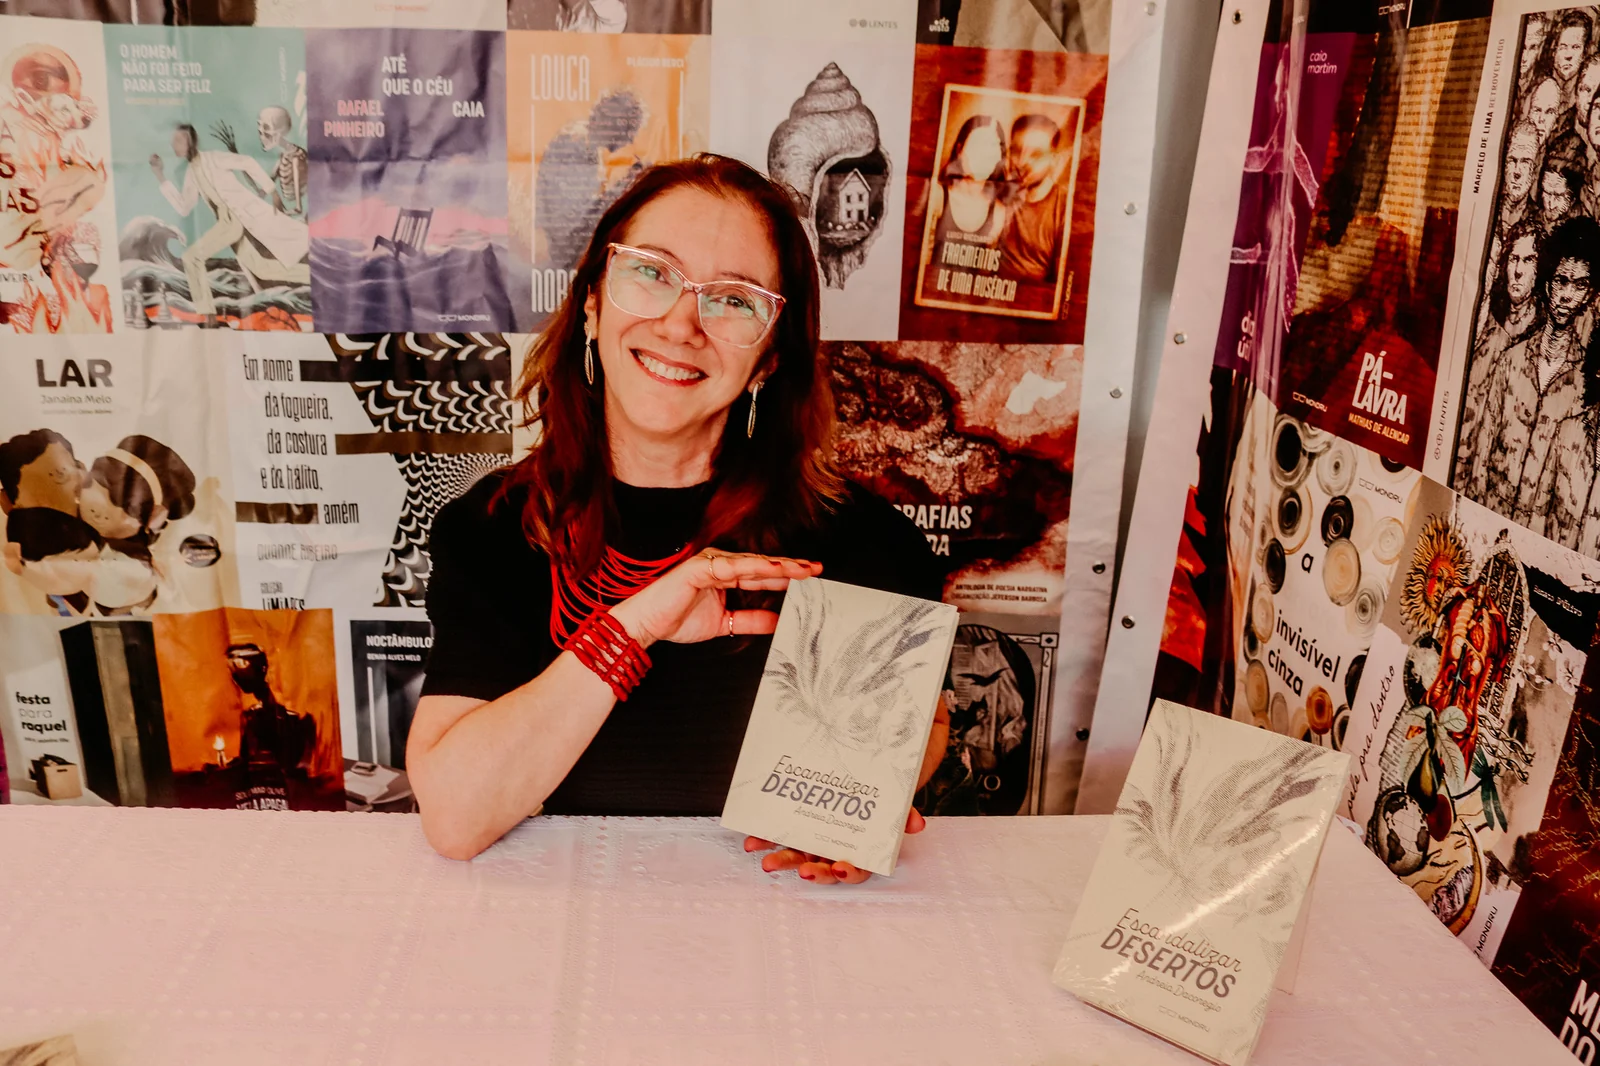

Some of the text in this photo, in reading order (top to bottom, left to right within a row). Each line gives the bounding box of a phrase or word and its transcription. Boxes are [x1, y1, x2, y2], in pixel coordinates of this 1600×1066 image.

[869, 20, 898, 29] LENTES
[120, 44, 178, 59] O HOMEM
[1310, 50, 1328, 62] caio
[121, 59, 202, 76] NÃO FOI FEITO
[381, 53, 407, 74] ATÉ
[1307, 62, 1337, 74] martim
[123, 78, 211, 94] PARA SER FELIZ
[382, 75, 453, 97] QUE O CÉU
[337, 100, 384, 116] RAFAEL
[452, 101, 484, 118] CAIA
[1473, 38, 1505, 194] MARCELO DE LIMA RETROVERTIGO
[324, 121, 385, 138] PINHEIRO
[942, 242, 1001, 271] FRAGMENTOS
[937, 269, 1017, 302] DE UMA AUSÊNCIA
[36, 358, 113, 388] LAR
[243, 354, 294, 382] Em nome
[264, 391, 333, 422] da fogueira,
[1352, 379, 1408, 426] LAVRA
[1439, 389, 1449, 432] LENTES
[1348, 412, 1410, 446] MATHIAS DE ALENCAR
[267, 428, 328, 456] da costura
[260, 467, 267, 489] e
[271, 465, 285, 489] da
[1375, 486, 1403, 504] MONDRU
[323, 500, 359, 525] amém
[300, 543, 338, 562] RIBEIRO
[1301, 553, 1314, 573] a
[366, 633, 434, 648] NOCTÂMBULO
[1276, 609, 1341, 683] invisível
[1268, 649, 1303, 697] cinza
[16, 691, 51, 705] festa
[1370, 665, 1395, 730] dentro
[19, 708, 52, 720] para
[22, 720, 67, 735] raquel
[773, 754, 880, 798] Escandalizar
[761, 773, 876, 821] DESERTOS
[831, 838, 858, 851] MONDRU
[1476, 905, 1498, 952] MONDRU
[1100, 927, 1236, 998] DESERTOS
[1136, 970, 1173, 994] Andreia
[1178, 1014, 1211, 1033] MONDRU
